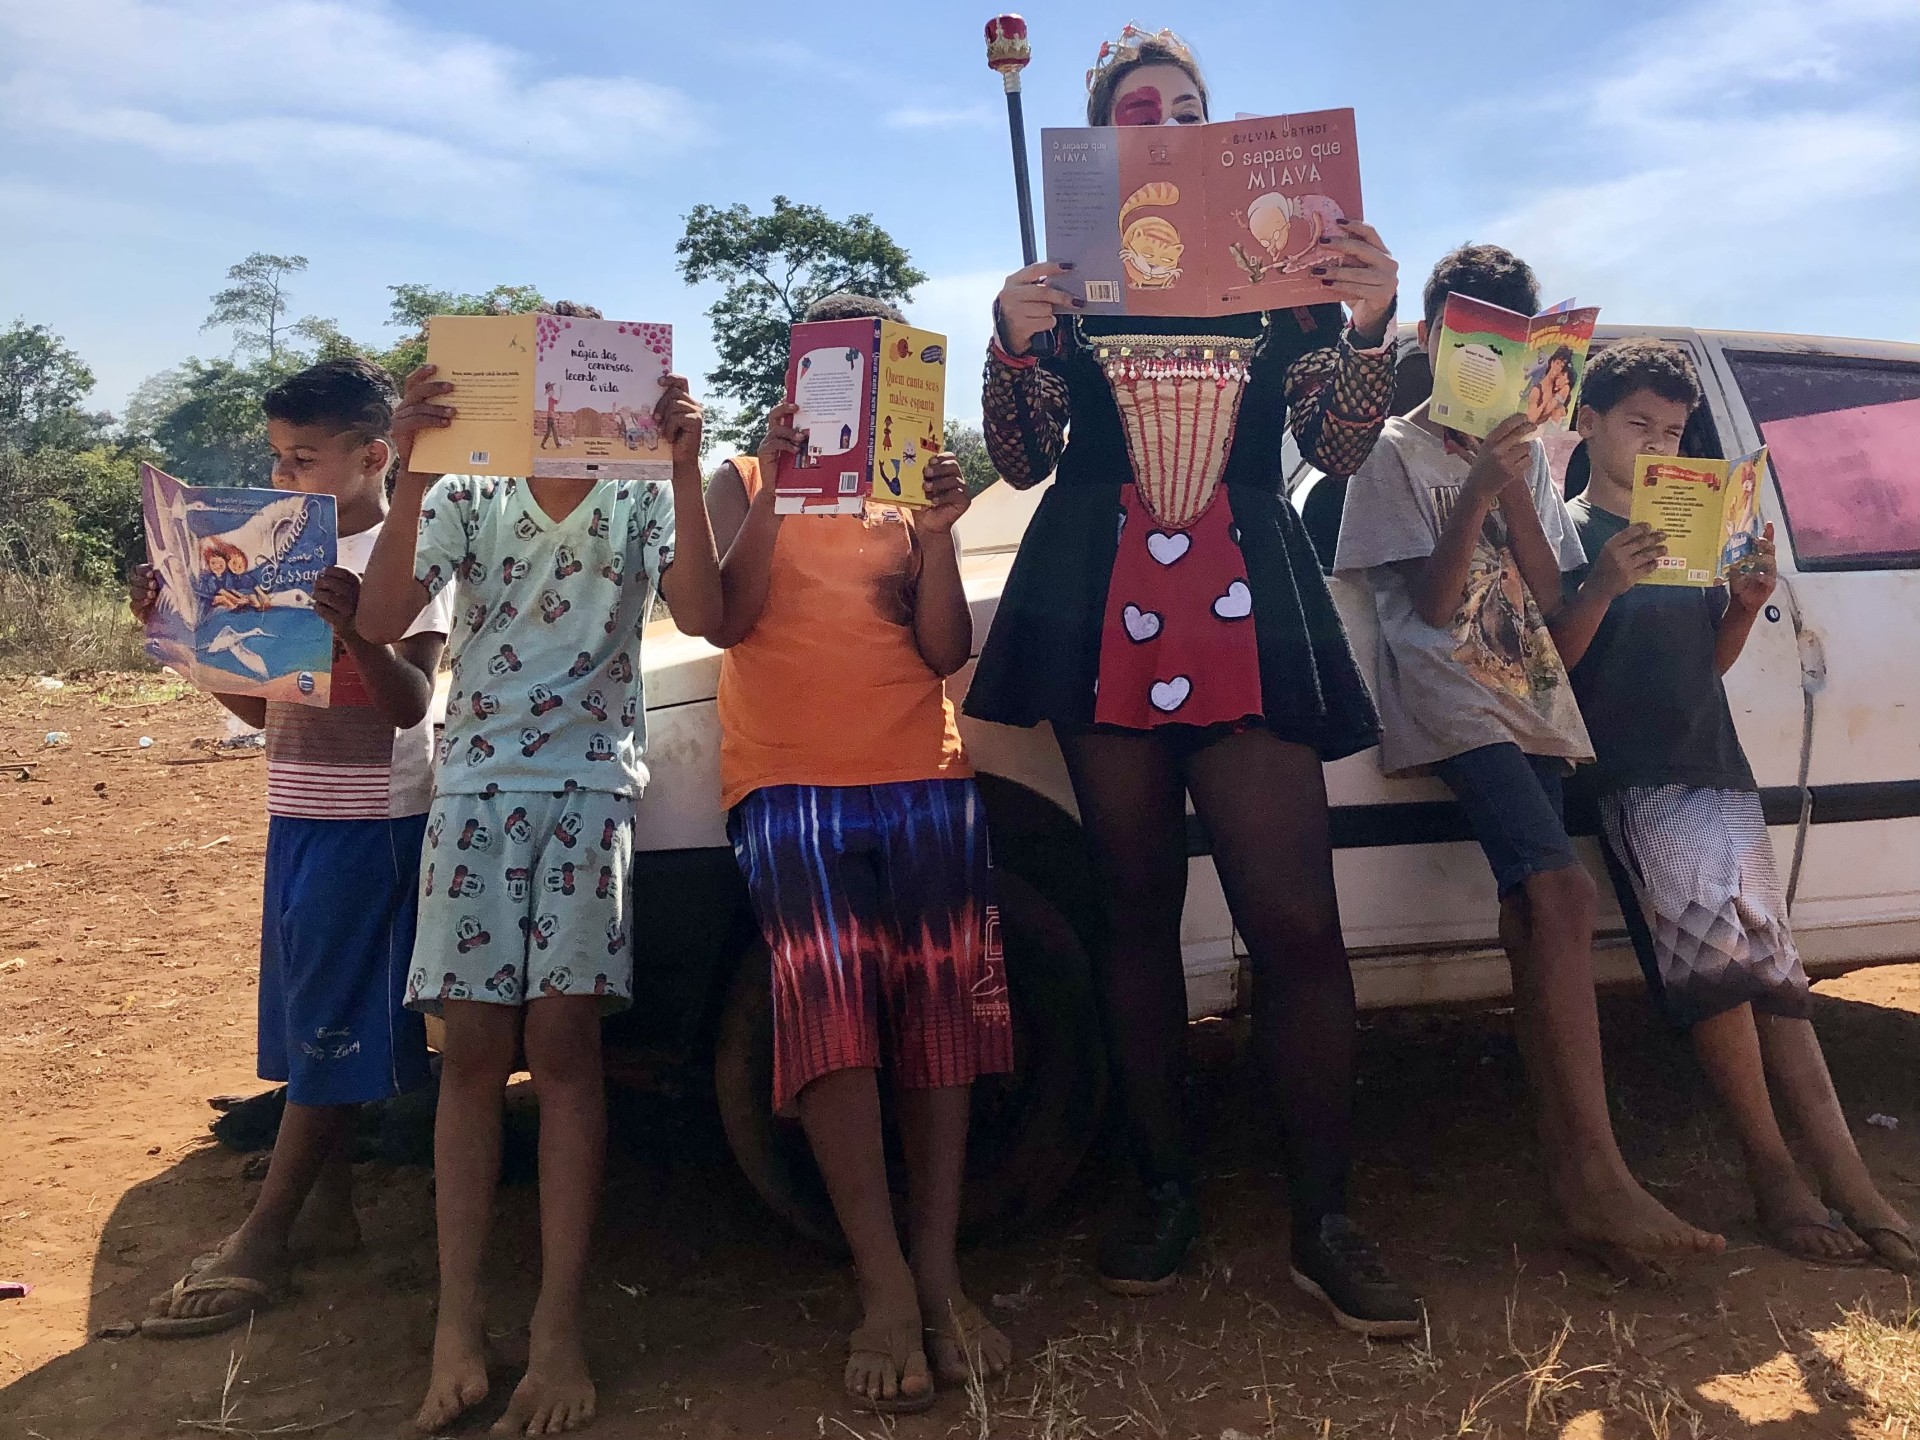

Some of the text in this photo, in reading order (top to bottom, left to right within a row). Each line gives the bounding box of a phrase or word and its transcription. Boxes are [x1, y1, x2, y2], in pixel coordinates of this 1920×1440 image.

[1233, 130, 1277, 145] SYLVIA
[1053, 152, 1088, 163] MIAVA
[1221, 141, 1341, 169] O sapato que
[1247, 162, 1322, 191] MIAVA
[571, 348, 618, 361] magia das
[598, 381, 619, 393] vida
[885, 366, 940, 393] Quem canta seus
[889, 389, 935, 412] males espanta
